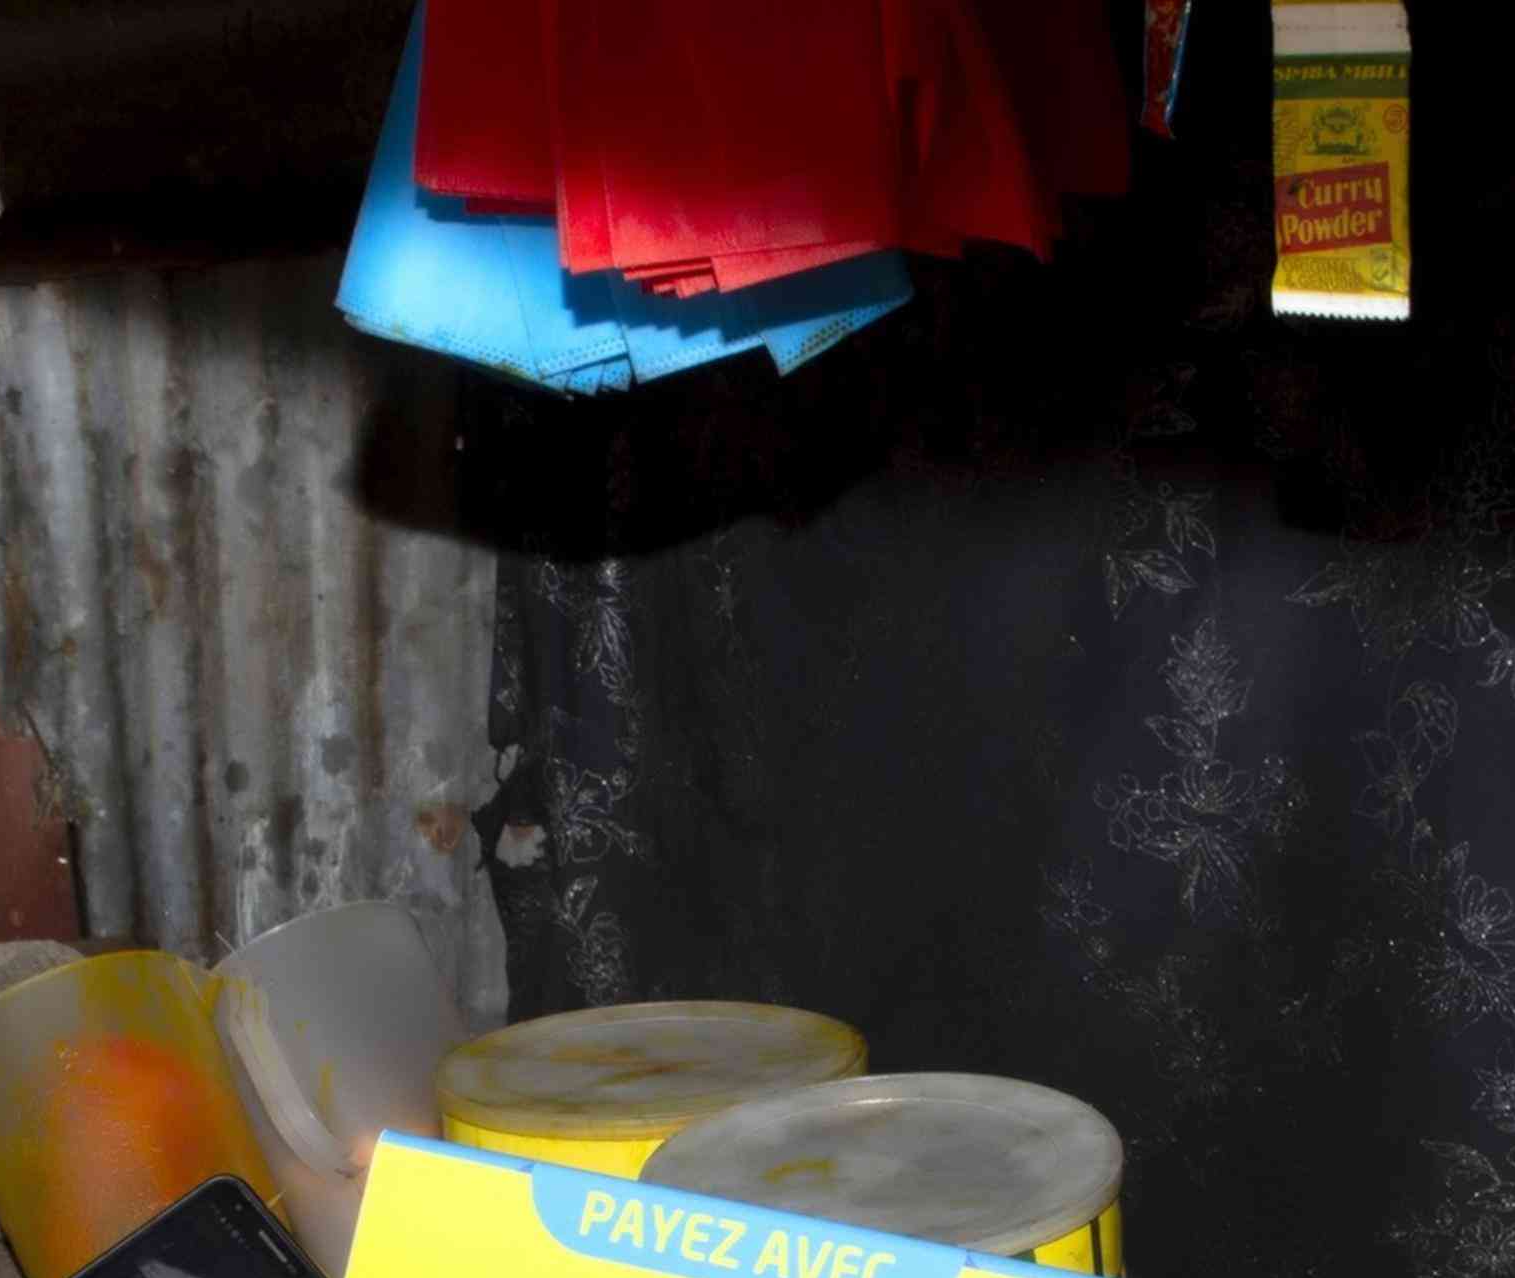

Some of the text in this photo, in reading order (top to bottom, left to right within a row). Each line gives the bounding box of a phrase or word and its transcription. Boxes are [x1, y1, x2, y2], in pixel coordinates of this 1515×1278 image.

[1297, 178, 1382, 208] Curry
[1282, 207, 1382, 245] Powder
[579, 1190, 749, 1270] PAYEZ
